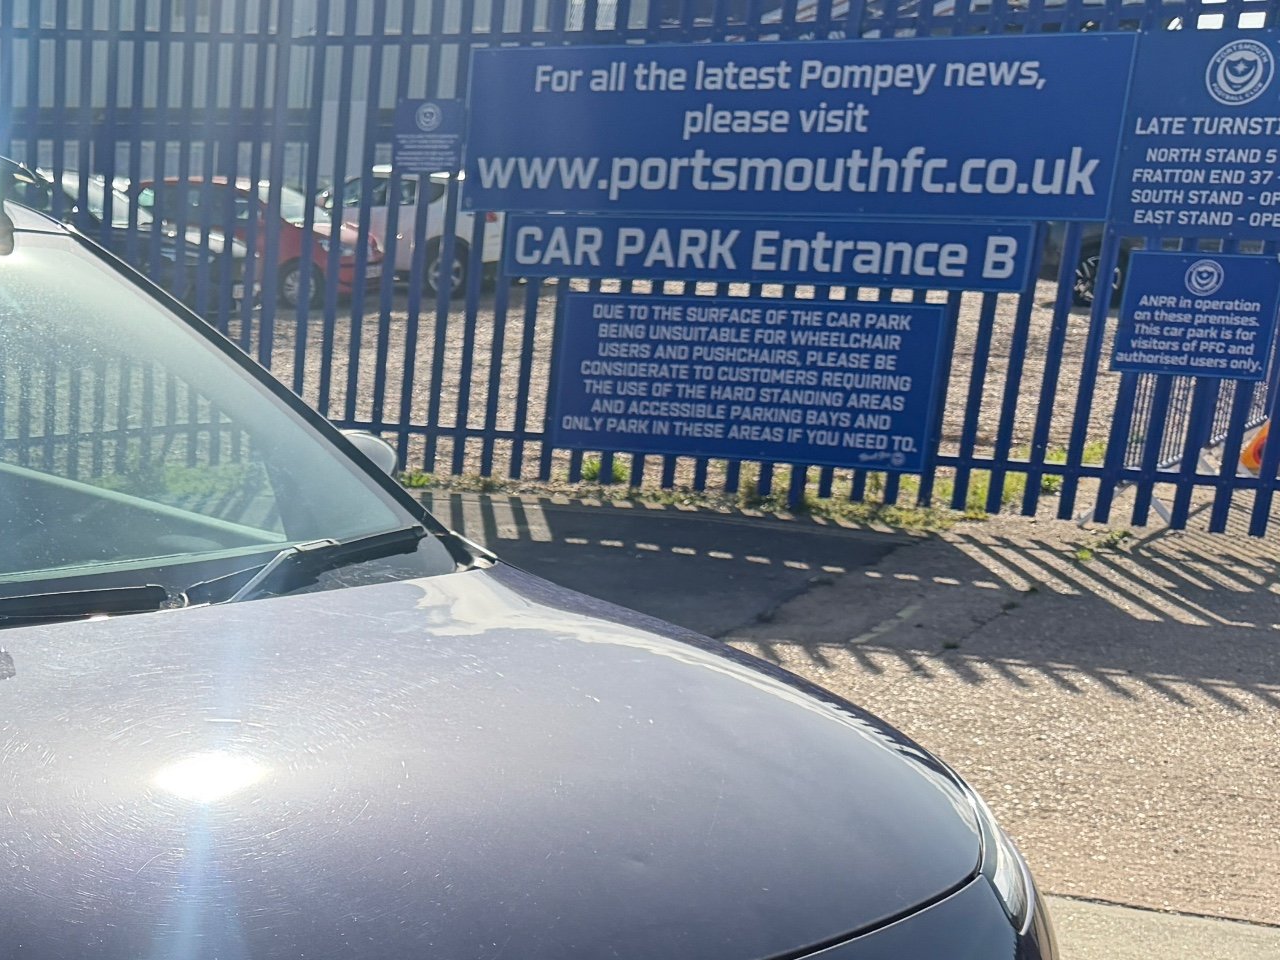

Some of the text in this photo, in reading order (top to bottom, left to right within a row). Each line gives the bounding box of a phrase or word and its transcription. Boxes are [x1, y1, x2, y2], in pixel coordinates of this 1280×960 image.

[535, 59, 1046, 95] For all the latest Pompey news,
[682, 102, 869, 140] please visit
[1135, 117, 1187, 135] LATE
[1146, 148, 1201, 163] NORTH
[1205, 148, 1261, 163] STAND
[477, 146, 1100, 201] www.portsmouthfc.co.uk
[1132, 168, 1274, 184] FRATTON END 37
[1131, 189, 1184, 204] SOUTH
[1188, 190, 1243, 205] STAND
[1133, 209, 1175, 224] EAST
[1178, 210, 1233, 225] STAND
[515, 225, 1019, 280] CAR PARK Entrance B
[1139, 295, 1261, 312] ANPR in operation
[593, 304, 912, 331] DUE TO THE SURFACE OF THE CAR PARK
[1134, 310, 1260, 327] on these premises.
[598, 323, 901, 350] BEING UNSUITABLE FOR WHEELCHAIR
[1134, 323, 1256, 341] This car park is for
[598, 342, 897, 371] USERS AND PUSHCHAIRS, PLEASE BE
[1130, 337, 1255, 356] visitors of PFC and
[1115, 351, 1263, 373] authorised users only.
[580, 361, 912, 392] CONSIDERATE TO CUSTOMERS REQUIRING
[584, 379, 905, 411] THE USE OF THE HARD STANDING AREAS
[591, 399, 891, 430] AND ACCESSIBLE PARKING BAYS AND
[562, 415, 917, 452] ONLY PARK IN THESE AREAS IF YOU NEED TO.
